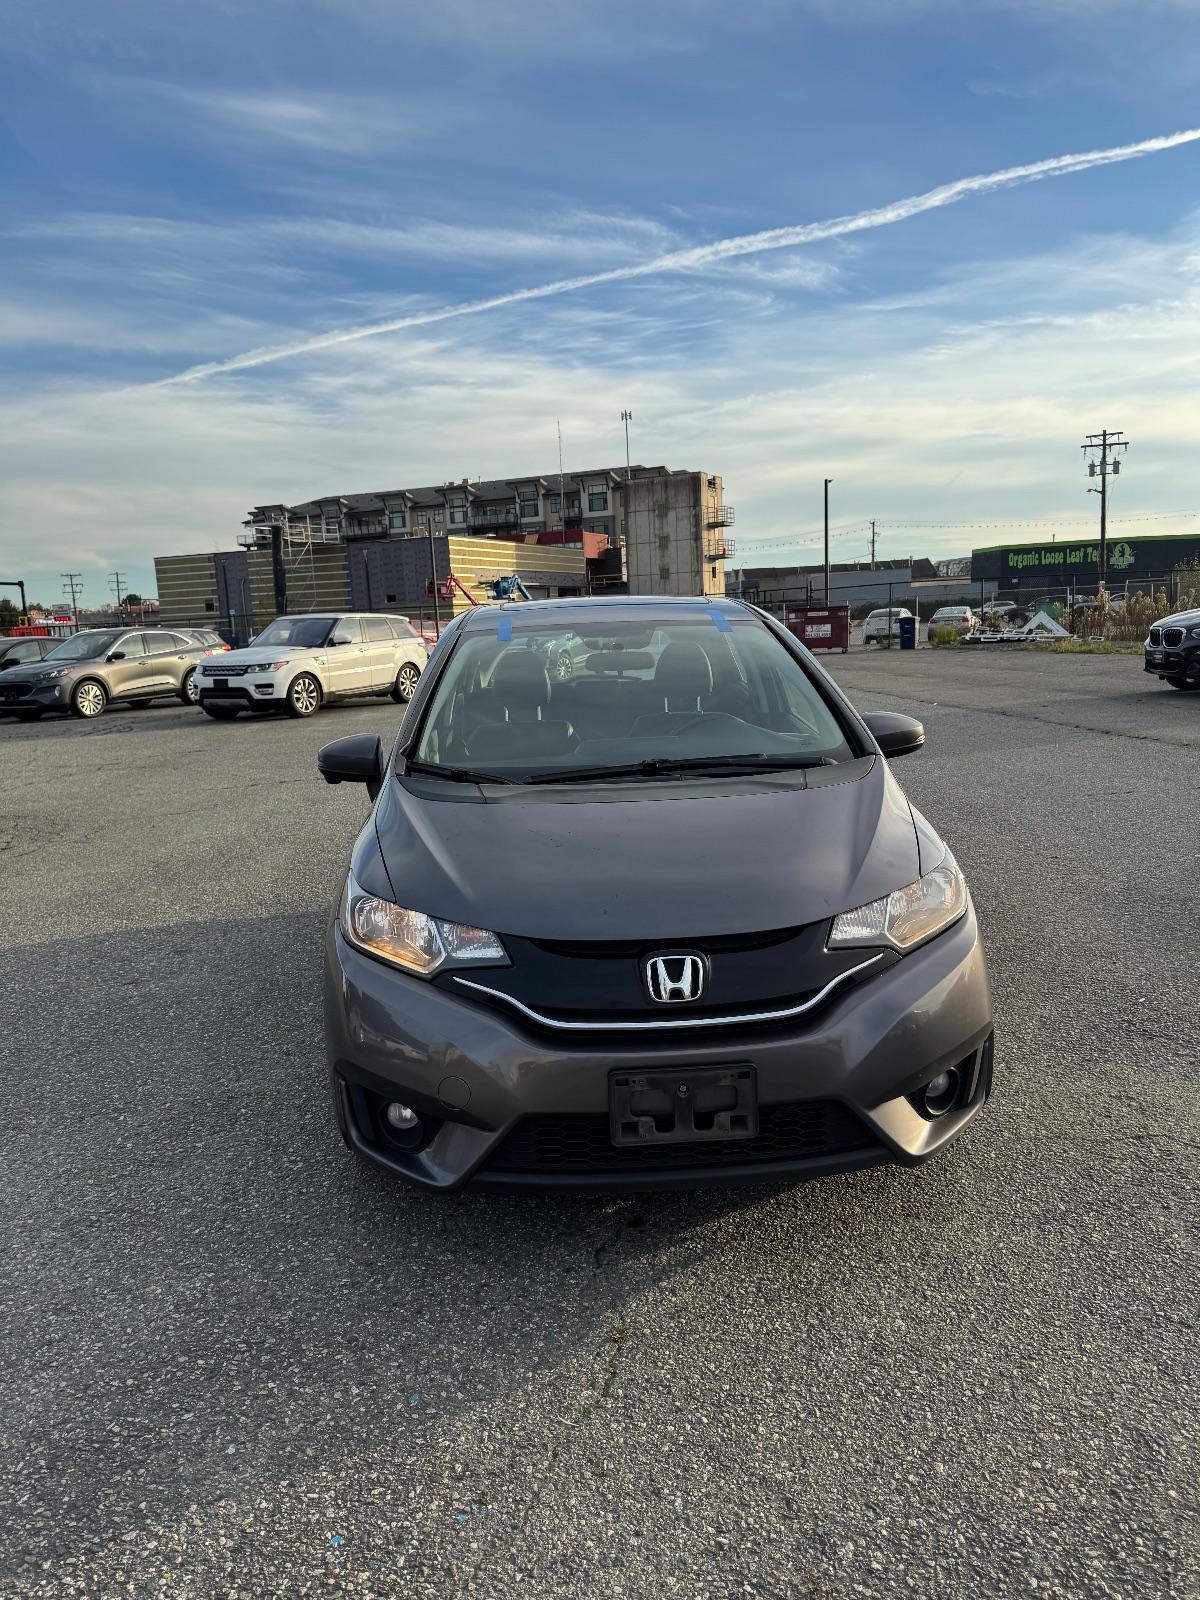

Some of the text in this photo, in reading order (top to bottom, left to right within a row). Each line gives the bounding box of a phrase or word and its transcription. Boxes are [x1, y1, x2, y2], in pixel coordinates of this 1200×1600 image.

[1008, 552, 1039, 568] Organic
[1041, 551, 1064, 564] Loose
[1066, 548, 1085, 563] Leaf
